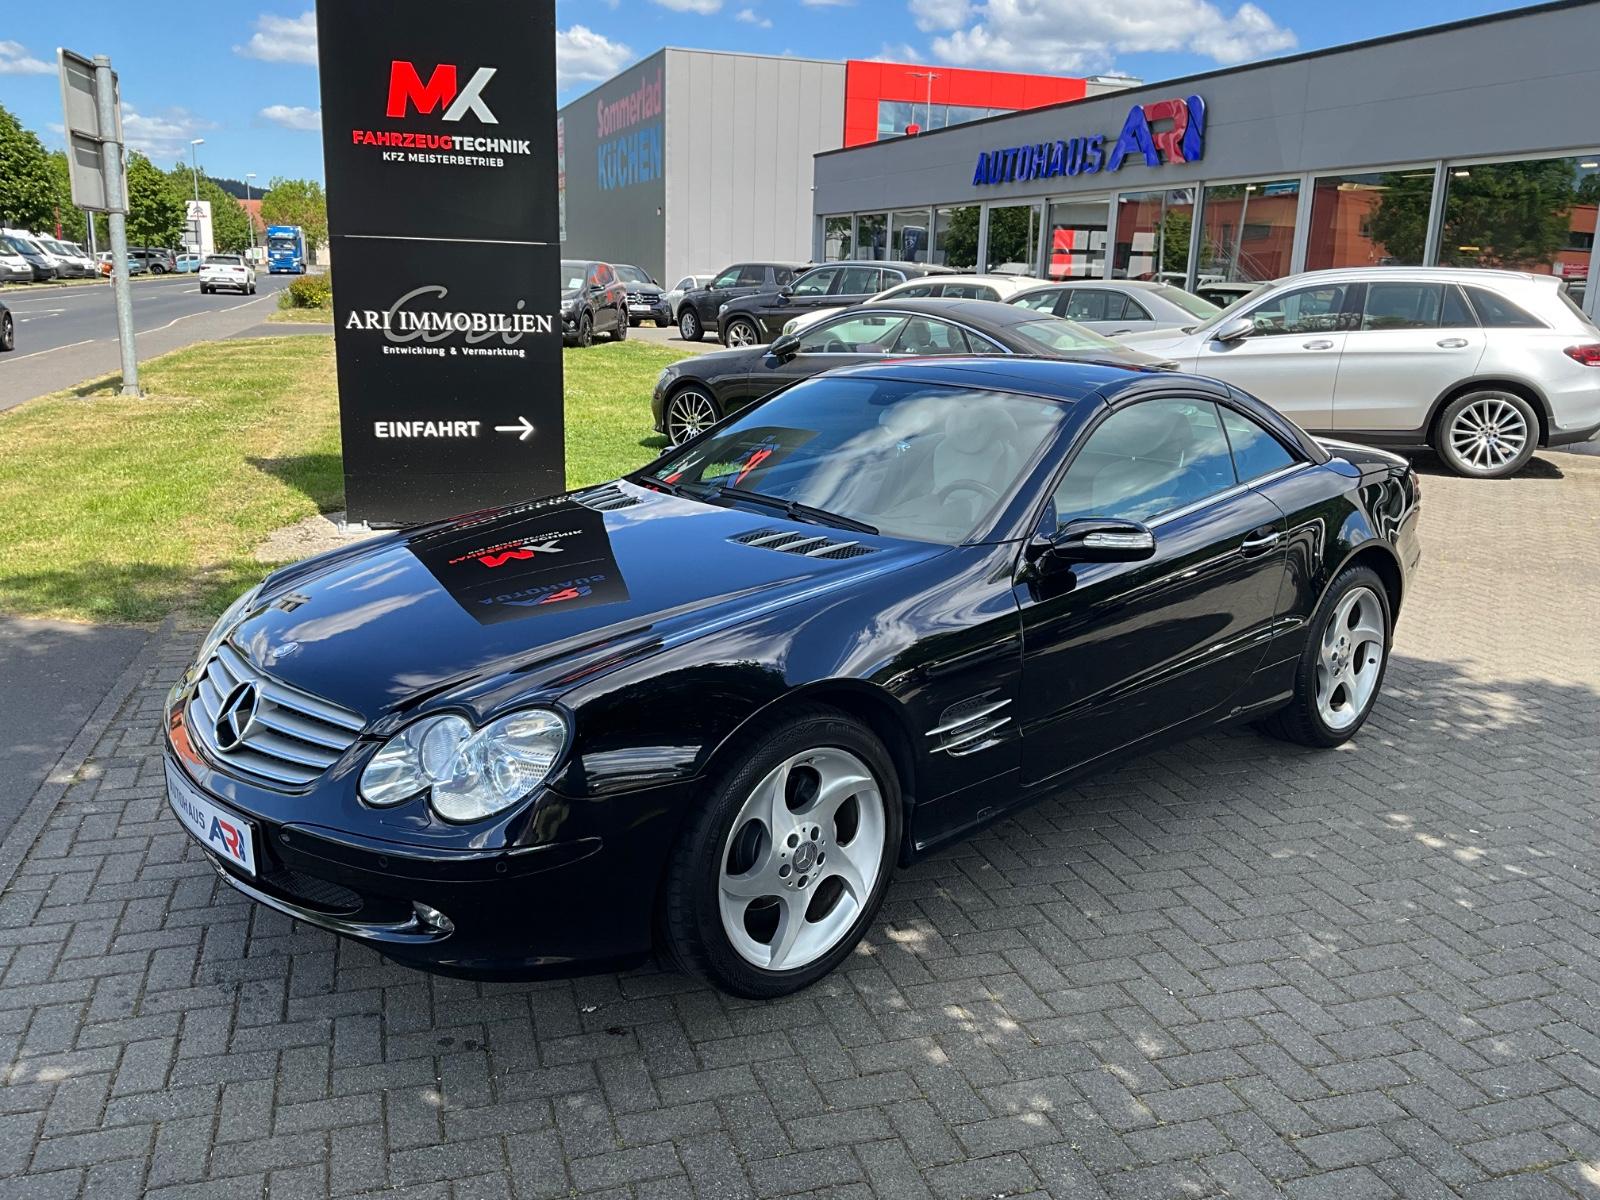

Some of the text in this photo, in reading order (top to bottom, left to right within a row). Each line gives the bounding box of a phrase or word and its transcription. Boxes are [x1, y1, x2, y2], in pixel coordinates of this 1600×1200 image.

[386, 60, 499, 124] MK
[597, 68, 662, 138] Sommerlad
[352, 130, 531, 155] FAHRZEUGTECHNIK
[382, 151, 504, 167] KFZ MEISTERBETRIEB
[597, 122, 662, 191] KÜCHEN
[972, 94, 1207, 186] AUTOHAUS ARI
[345, 310, 553, 333] ARI IMMOBILIEN
[383, 345, 526, 358] Entwicklung & Vermarktung
[374, 421, 481, 438] EINFAHRT
[168, 778, 247, 863] AUTOHAUS ARI
